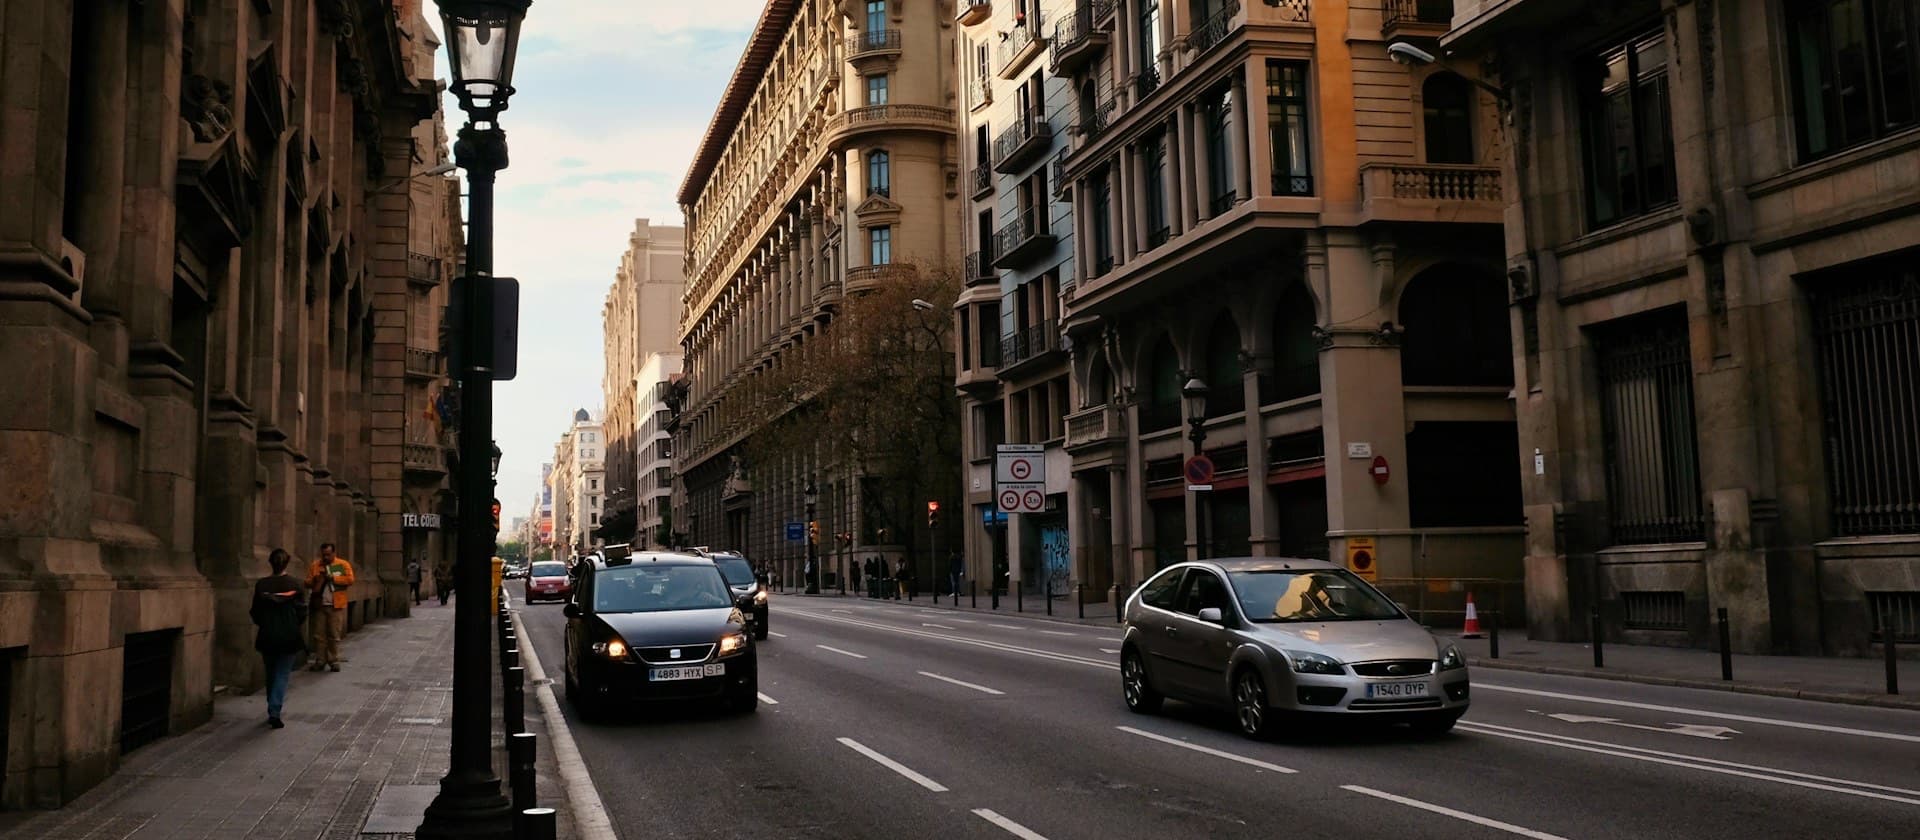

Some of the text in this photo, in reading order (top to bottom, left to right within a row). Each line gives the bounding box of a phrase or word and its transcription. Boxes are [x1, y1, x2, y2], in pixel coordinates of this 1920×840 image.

[1005, 496, 1015, 504] 10
[657, 668, 702, 679] 4883 HYX
[706, 664, 722, 675] SP
[1376, 684, 1400, 696] 1540
